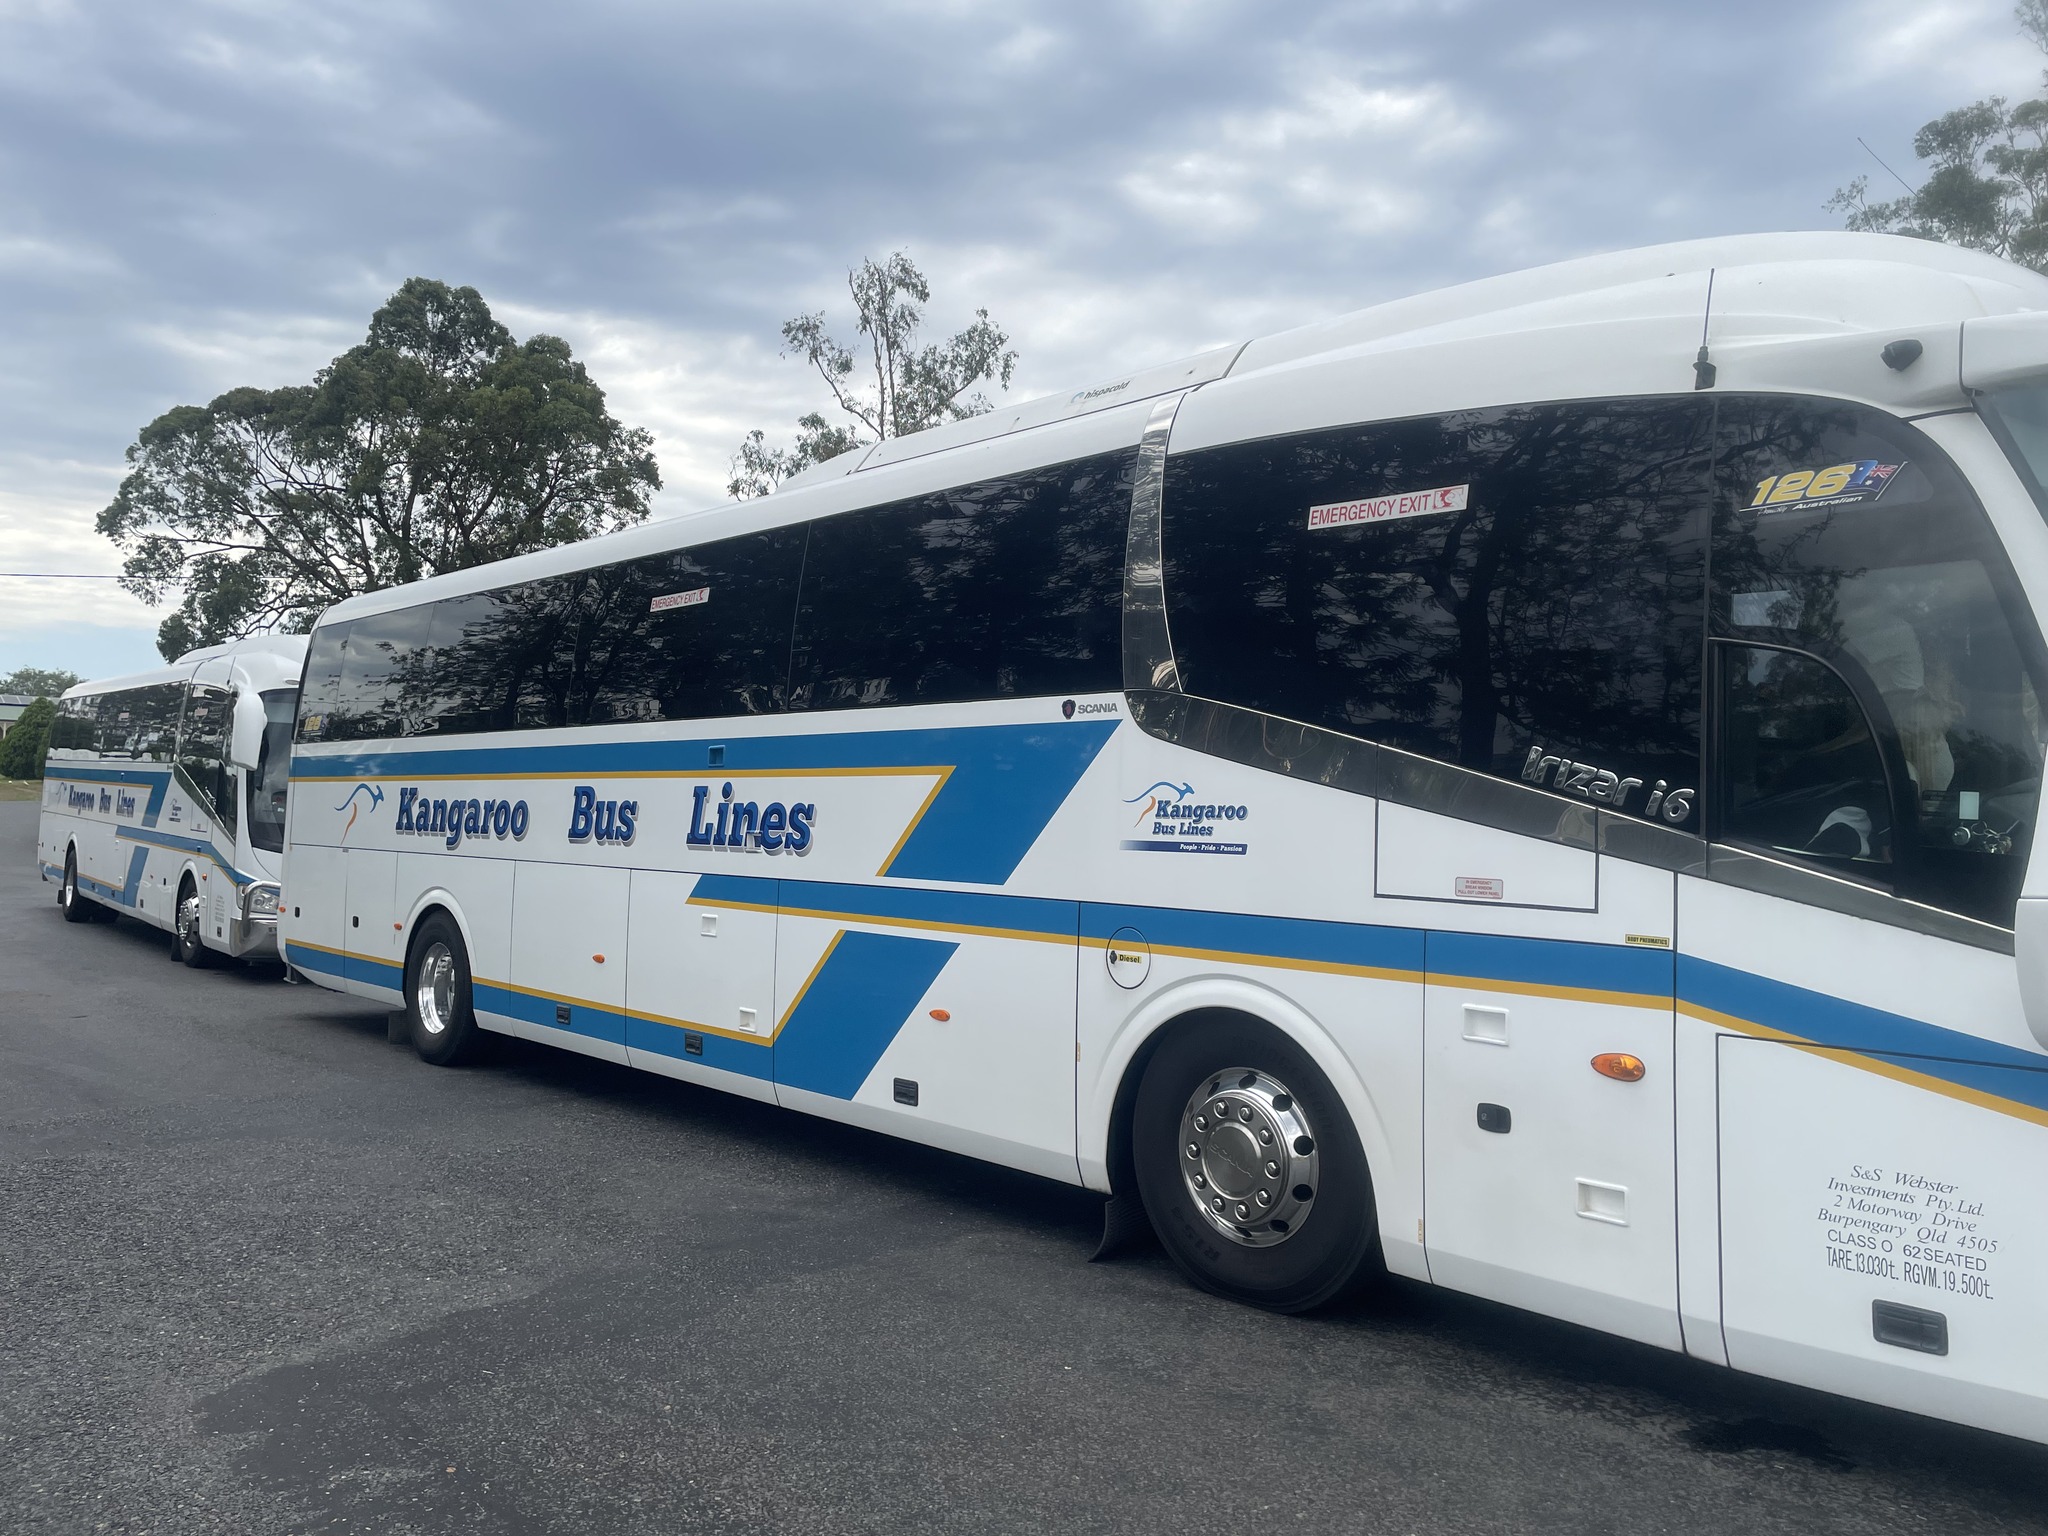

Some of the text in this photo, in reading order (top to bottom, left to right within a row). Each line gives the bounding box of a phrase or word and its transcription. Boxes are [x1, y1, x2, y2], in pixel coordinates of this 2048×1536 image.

[1751, 464, 1857, 506] 126
[1310, 494, 1432, 526] EMERGENCY EXIT
[1792, 495, 1863, 511] Australian
[652, 592, 697, 610] EMERGENCY EXIT
[1077, 702, 1118, 714] SCANIA
[1521, 745, 1695, 824] Irizar i6
[395, 781, 818, 858] Kangaroo Bus Lines
[1155, 799, 1248, 824] Kangaroo
[1152, 820, 1214, 836] Bus Lines
[1180, 843, 1243, 853] People Pride Passion
[1119, 954, 1141, 963] Diesel
[1827, 1177, 1916, 1204] Investments
[1850, 1165, 1959, 1195] S&S Webster
[1833, 1194, 1977, 1233] 2 Motorway Drive
[1817, 1208, 1999, 1254] Burpengary Qld 4505
[1827, 1229, 1877, 1250] CLASS
